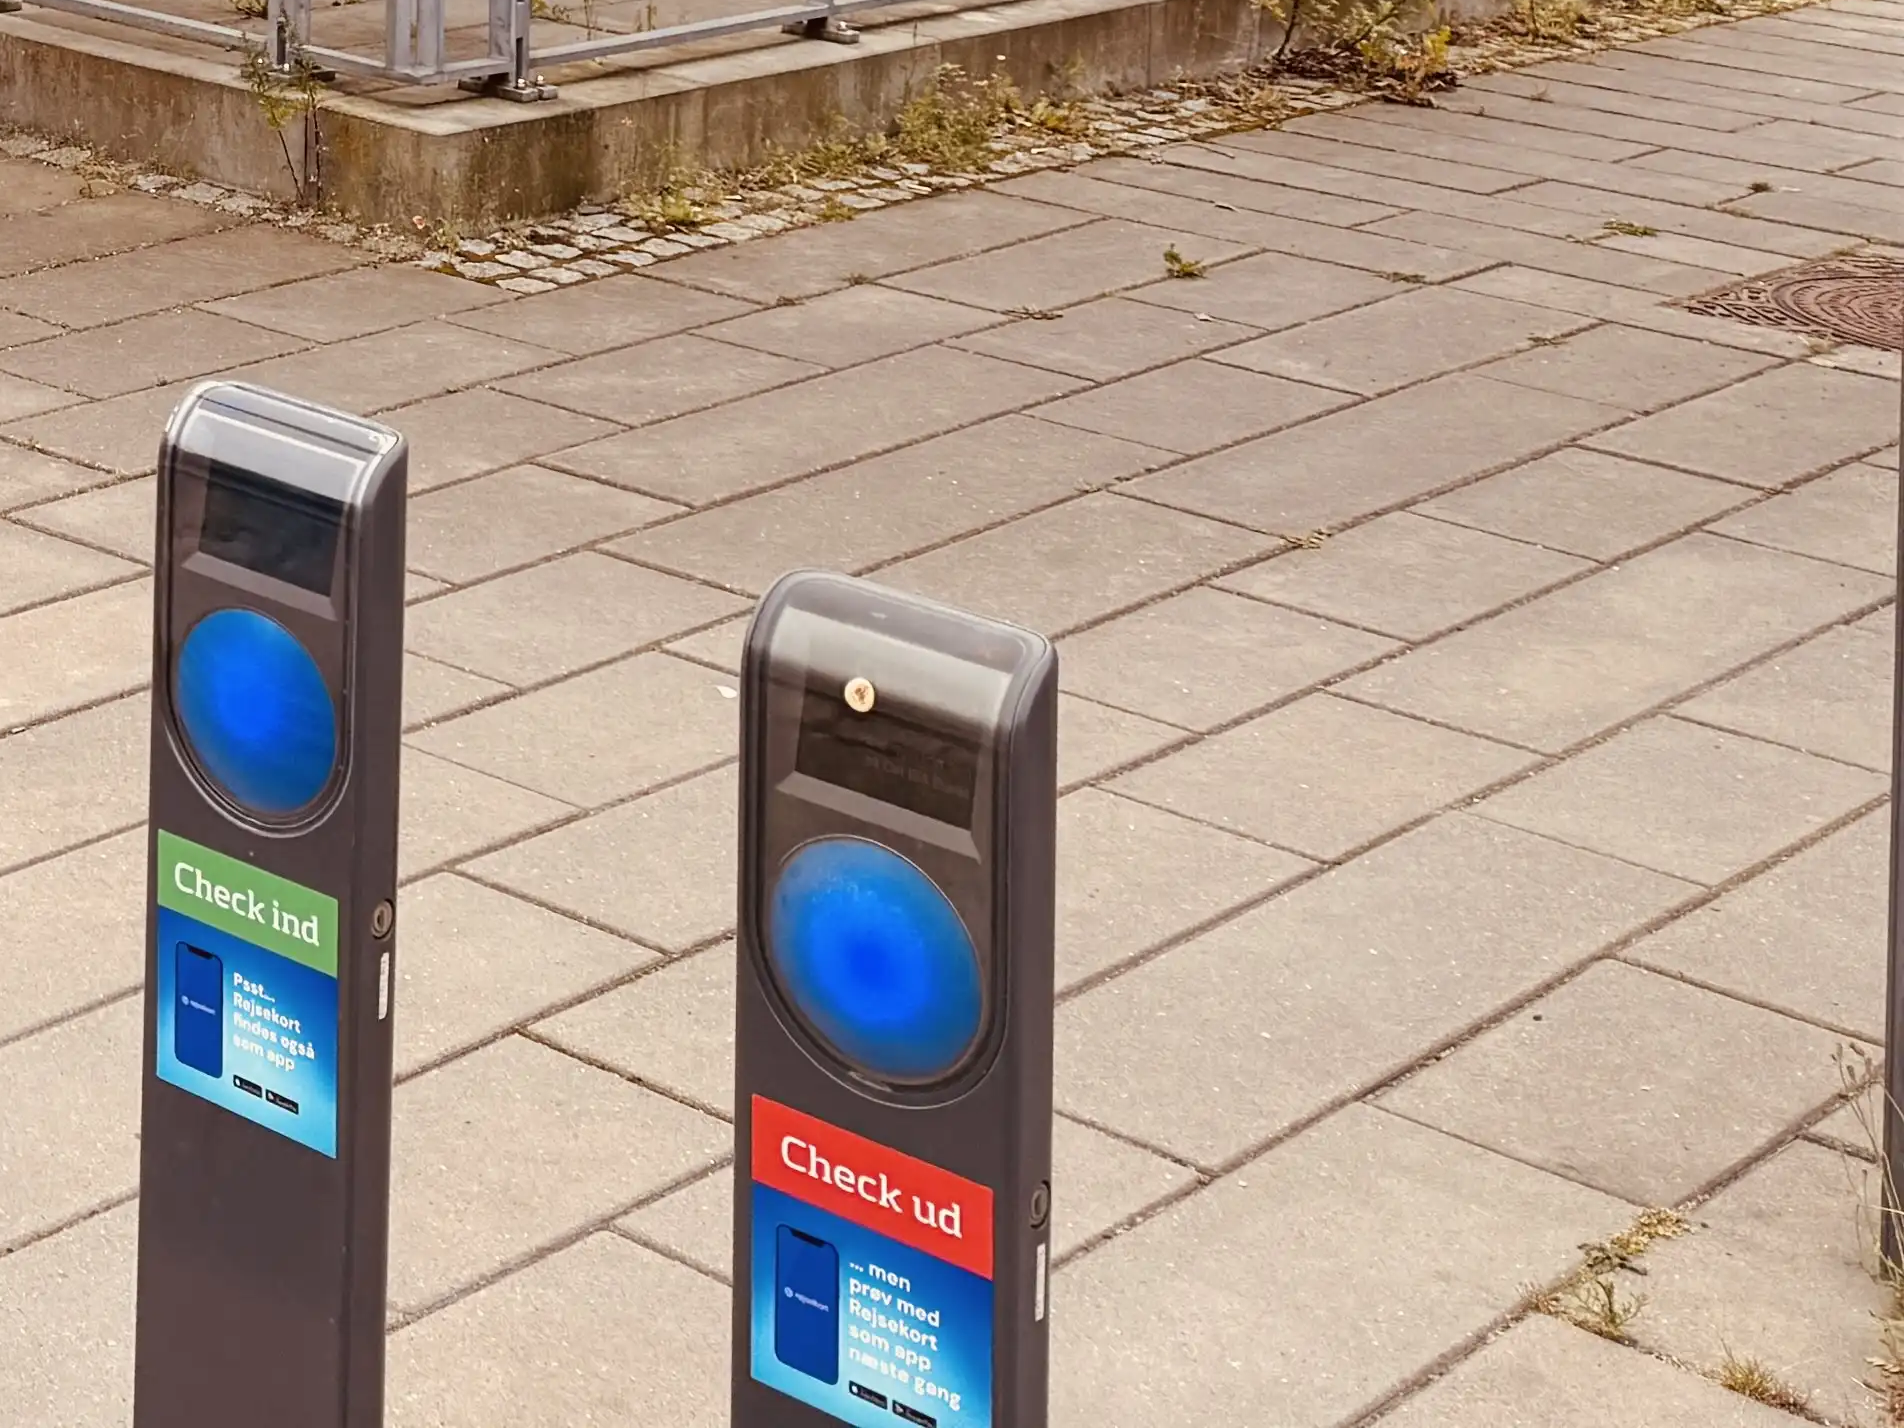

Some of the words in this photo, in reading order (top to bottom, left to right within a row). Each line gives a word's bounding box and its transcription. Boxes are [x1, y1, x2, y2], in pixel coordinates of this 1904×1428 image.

[174, 862, 265, 924] Check
[272, 899, 319, 946] ind
[233, 991, 301, 1034] Rejsekort
[233, 1012, 277, 1047] findes
[280, 1031, 315, 1061] også
[233, 1033, 264, 1057] som
[267, 1049, 295, 1073] app
[781, 1135, 903, 1213] Check
[912, 1195, 963, 1240] ud
[849, 1277, 891, 1307] prøv
[897, 1295, 940, 1328] med
[869, 1263, 911, 1293] men
[848, 1323, 890, 1351] som
[895, 1343, 932, 1372] app
[849, 1299, 938, 1351] Rejsekort
[849, 1346, 910, 1383] næste
[913, 1374, 962, 1411] gang
